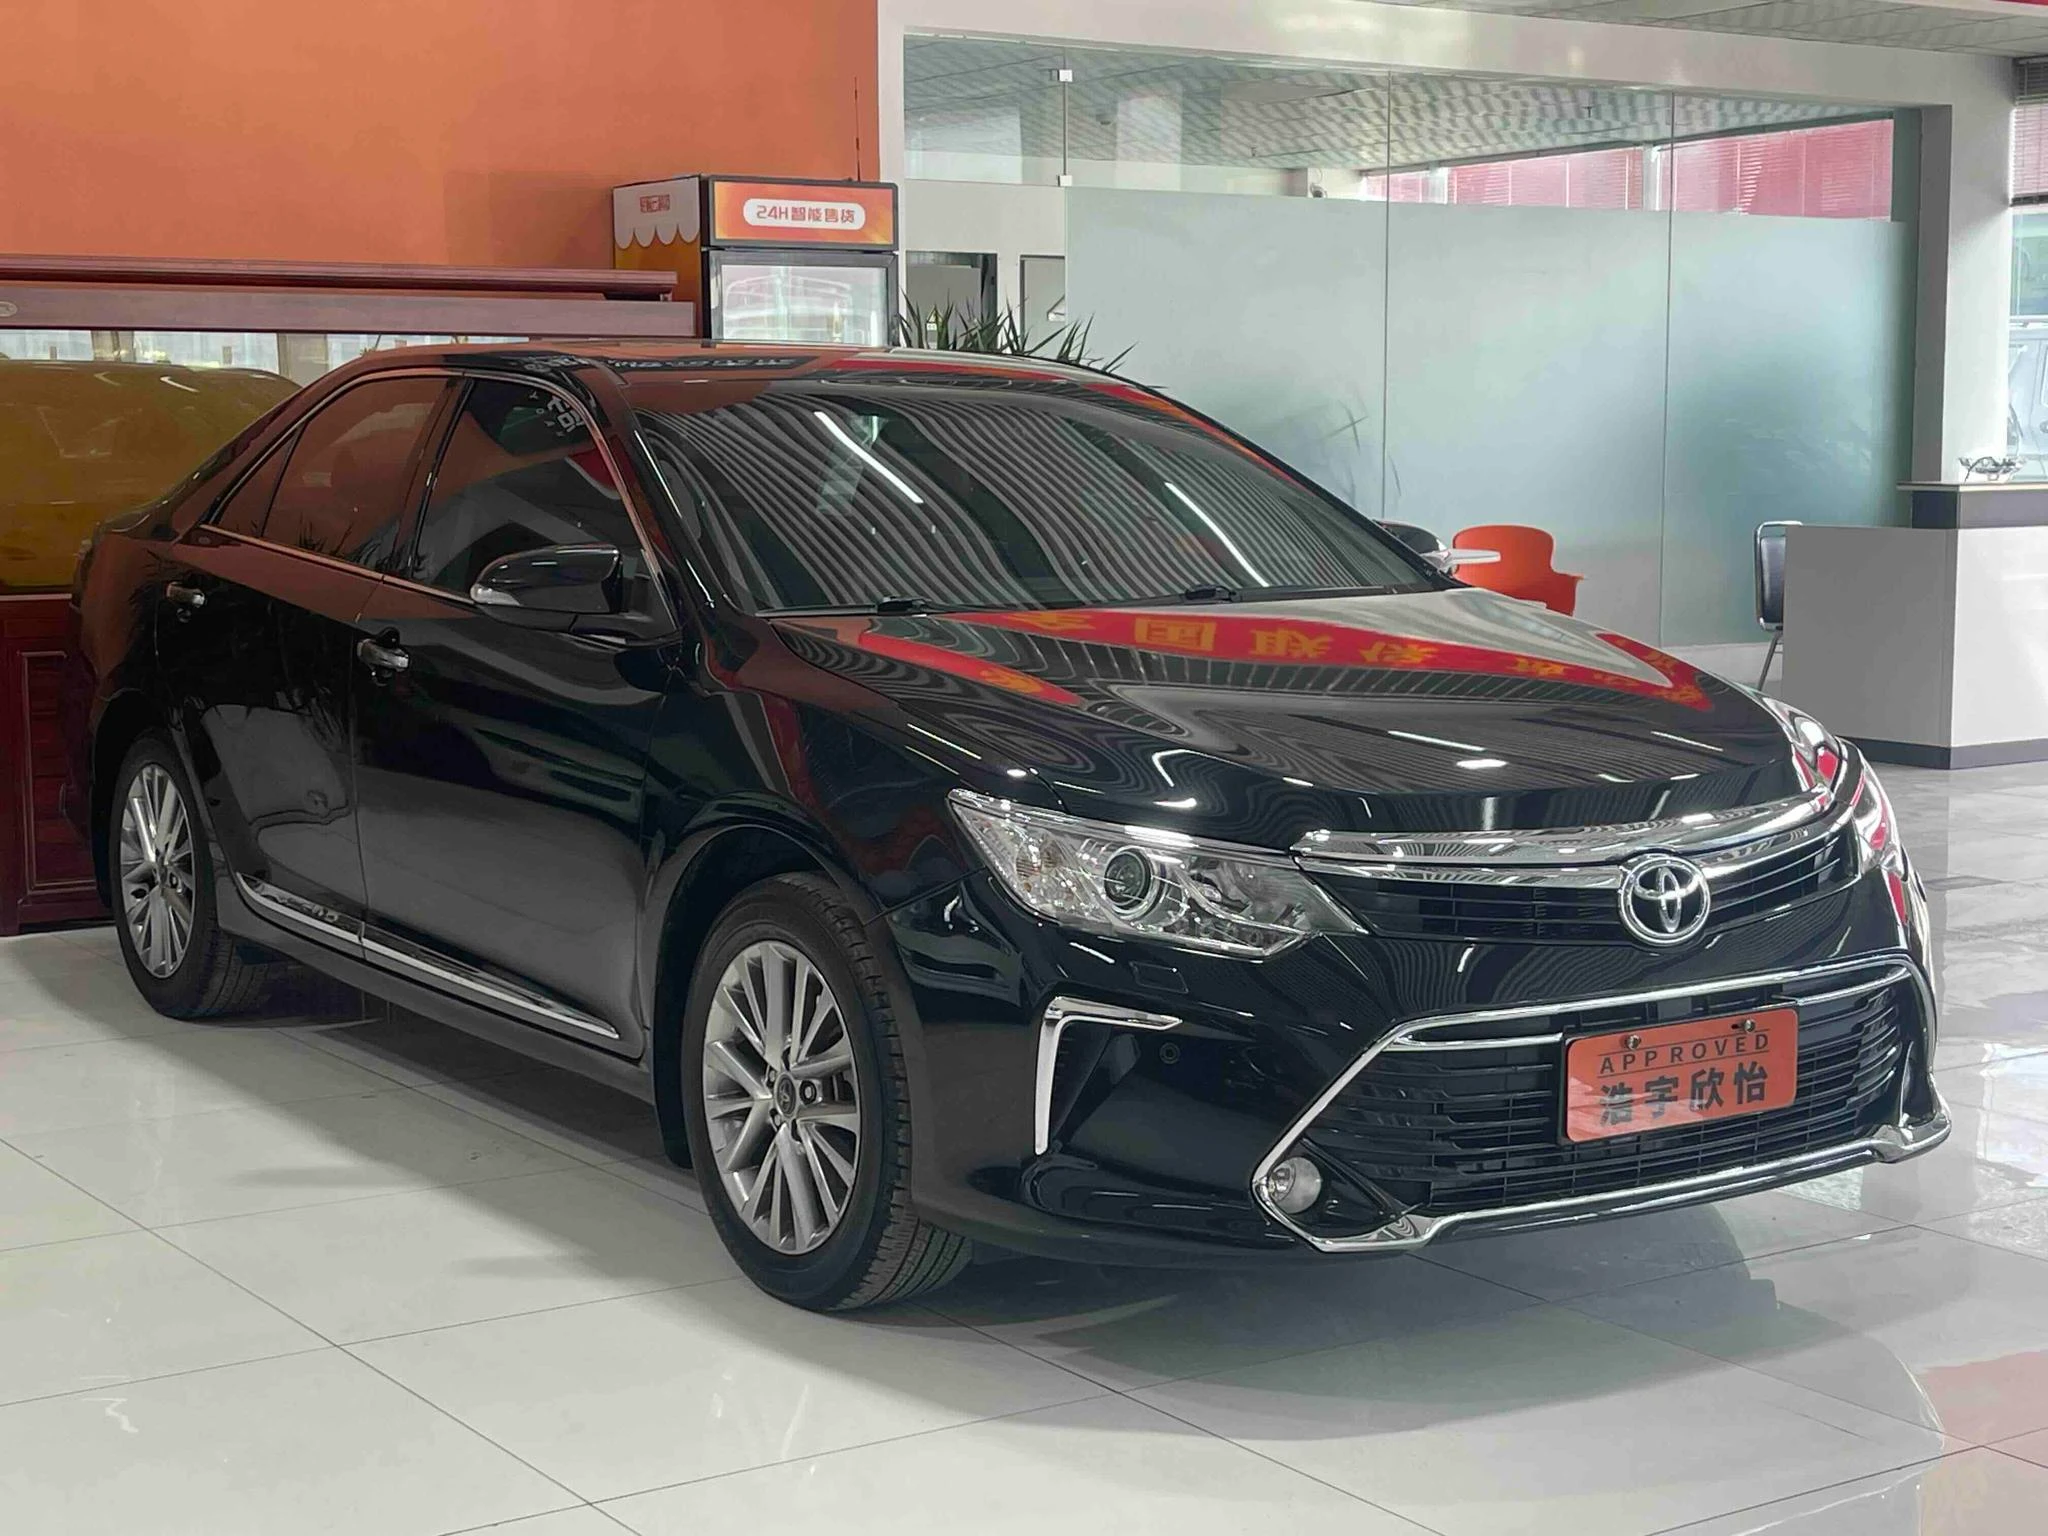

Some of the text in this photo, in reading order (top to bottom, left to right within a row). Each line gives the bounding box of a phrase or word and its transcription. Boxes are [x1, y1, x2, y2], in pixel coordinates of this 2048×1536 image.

[1600, 1033, 1769, 1074] APPROVED
[1600, 1061, 1768, 1127] 浩宇欣怡
